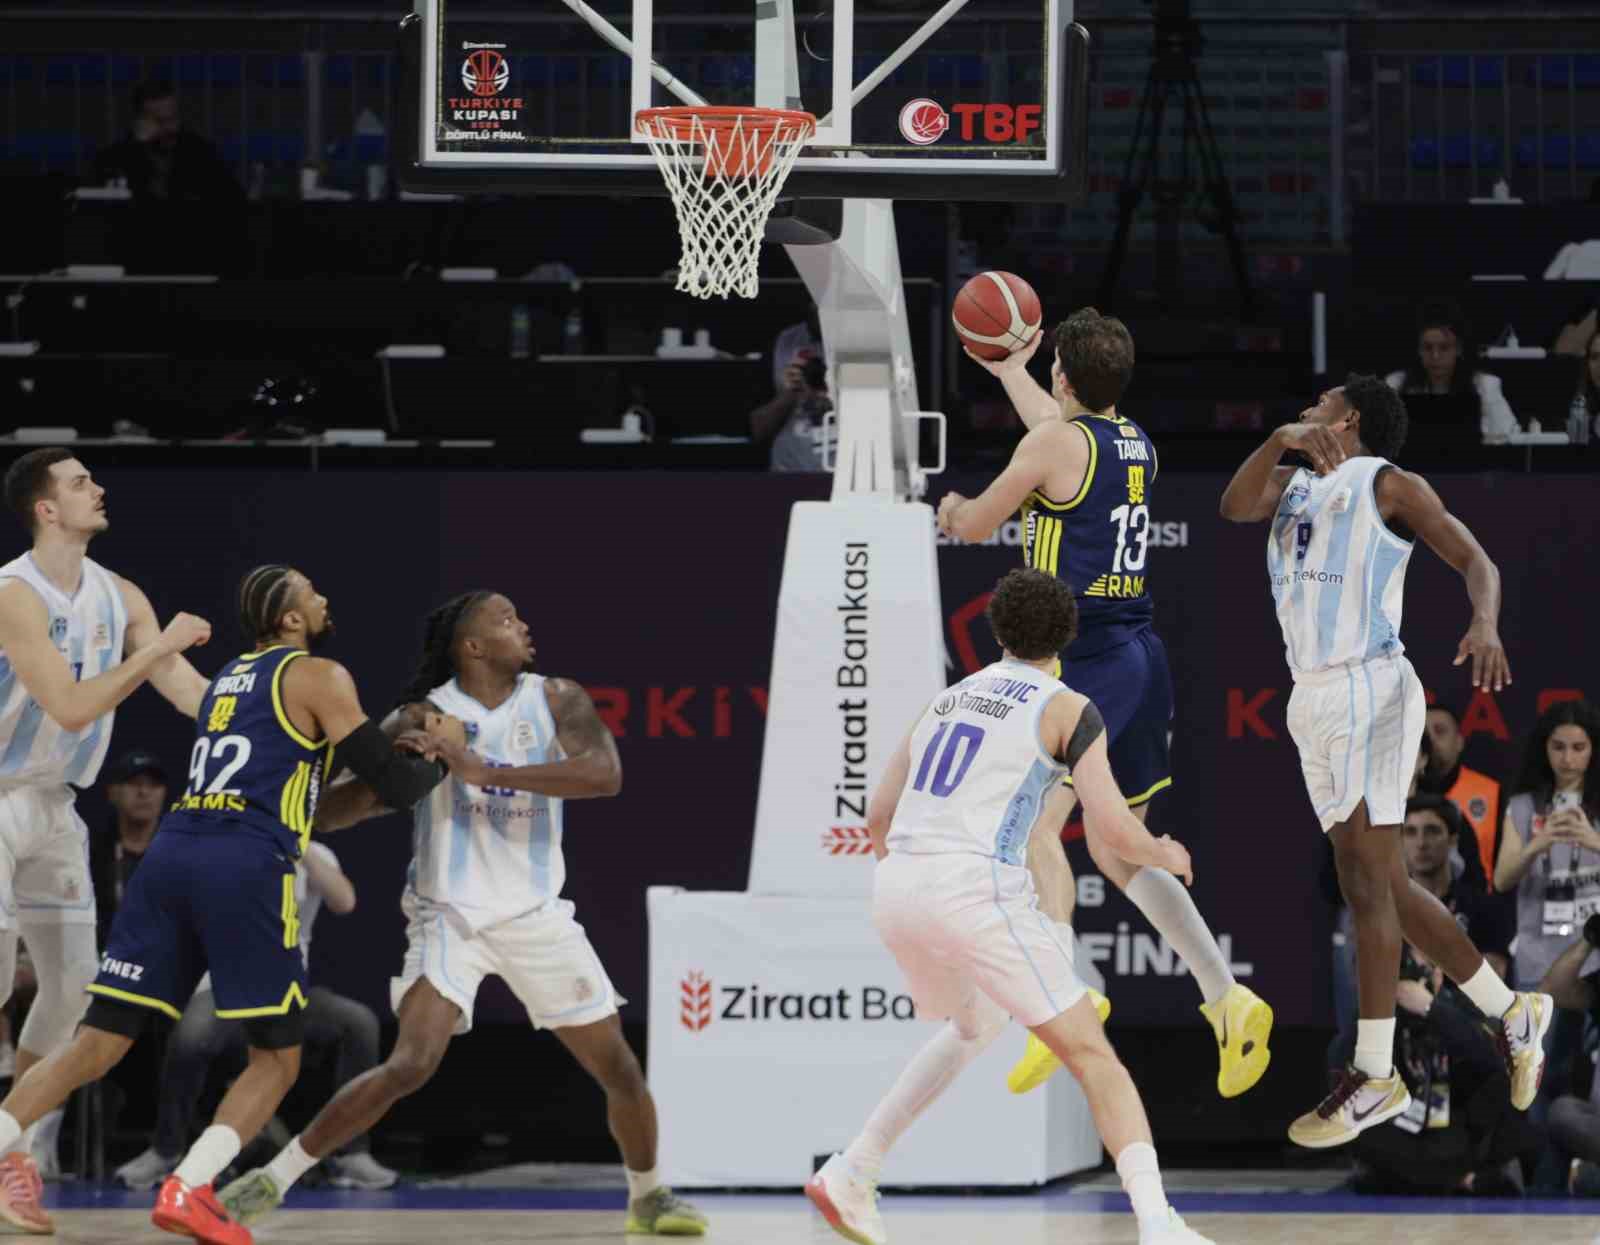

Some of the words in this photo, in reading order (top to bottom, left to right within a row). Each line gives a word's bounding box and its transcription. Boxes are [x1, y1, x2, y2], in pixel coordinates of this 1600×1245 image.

[453, 110, 517, 120] KUPASI
[952, 104, 1041, 143] TBF
[1110, 504, 1149, 573] 13
[837, 542, 868, 687] Bankası
[1107, 575, 1144, 598] RAM
[187, 734, 252, 797] 92
[835, 698, 867, 818] Ziraat
[913, 721, 986, 798] 10
[1076, 921, 1253, 976] FİNL
[721, 984, 850, 1020] Ziraat
[863, 988, 916, 1020] Ba
